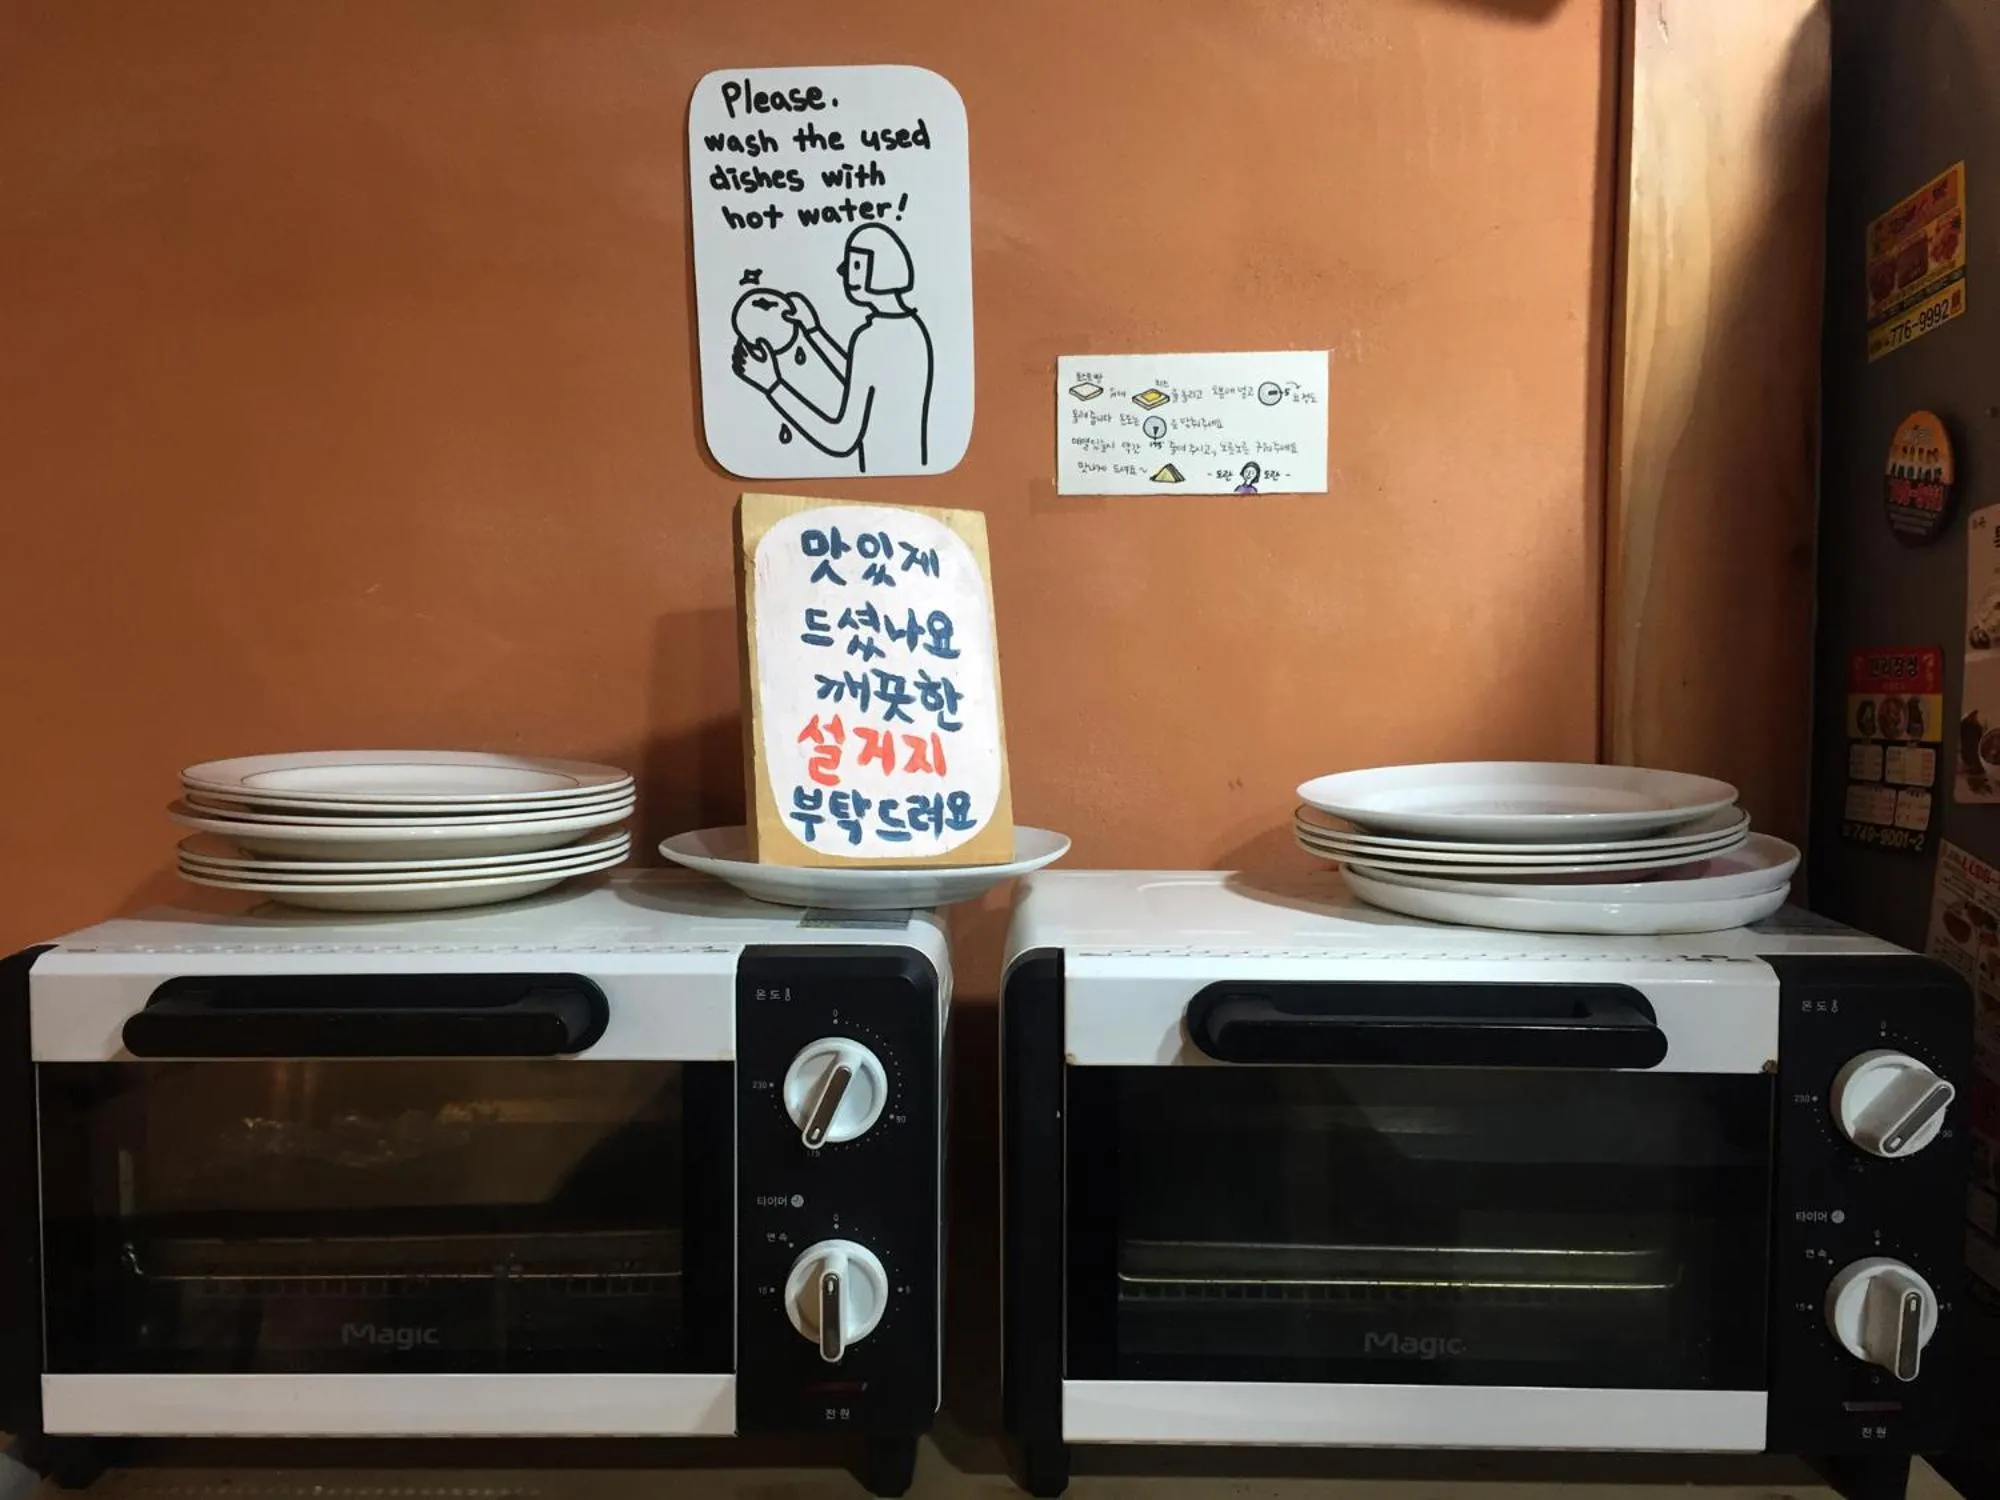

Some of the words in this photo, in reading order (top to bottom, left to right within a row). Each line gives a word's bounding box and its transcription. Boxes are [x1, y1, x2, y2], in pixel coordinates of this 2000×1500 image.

[704, 129, 779, 157] wash
[793, 122, 845, 152] the
[860, 118, 931, 150] used
[709, 164, 805, 193] dishes
[821, 160, 886, 189] with
[721, 204, 784, 229] hot
[797, 192, 908, 227] water!
[1889, 298, 1950, 347] 776-9992
[800, 601, 961, 662] 드셨나요
[814, 668, 964, 733] 깨끗한
[797, 713, 947, 787] 설거지
[832, 1008, 839, 1018] 0
[341, 1322, 440, 1352] Magic
[1364, 1331, 1463, 1361] Magic
